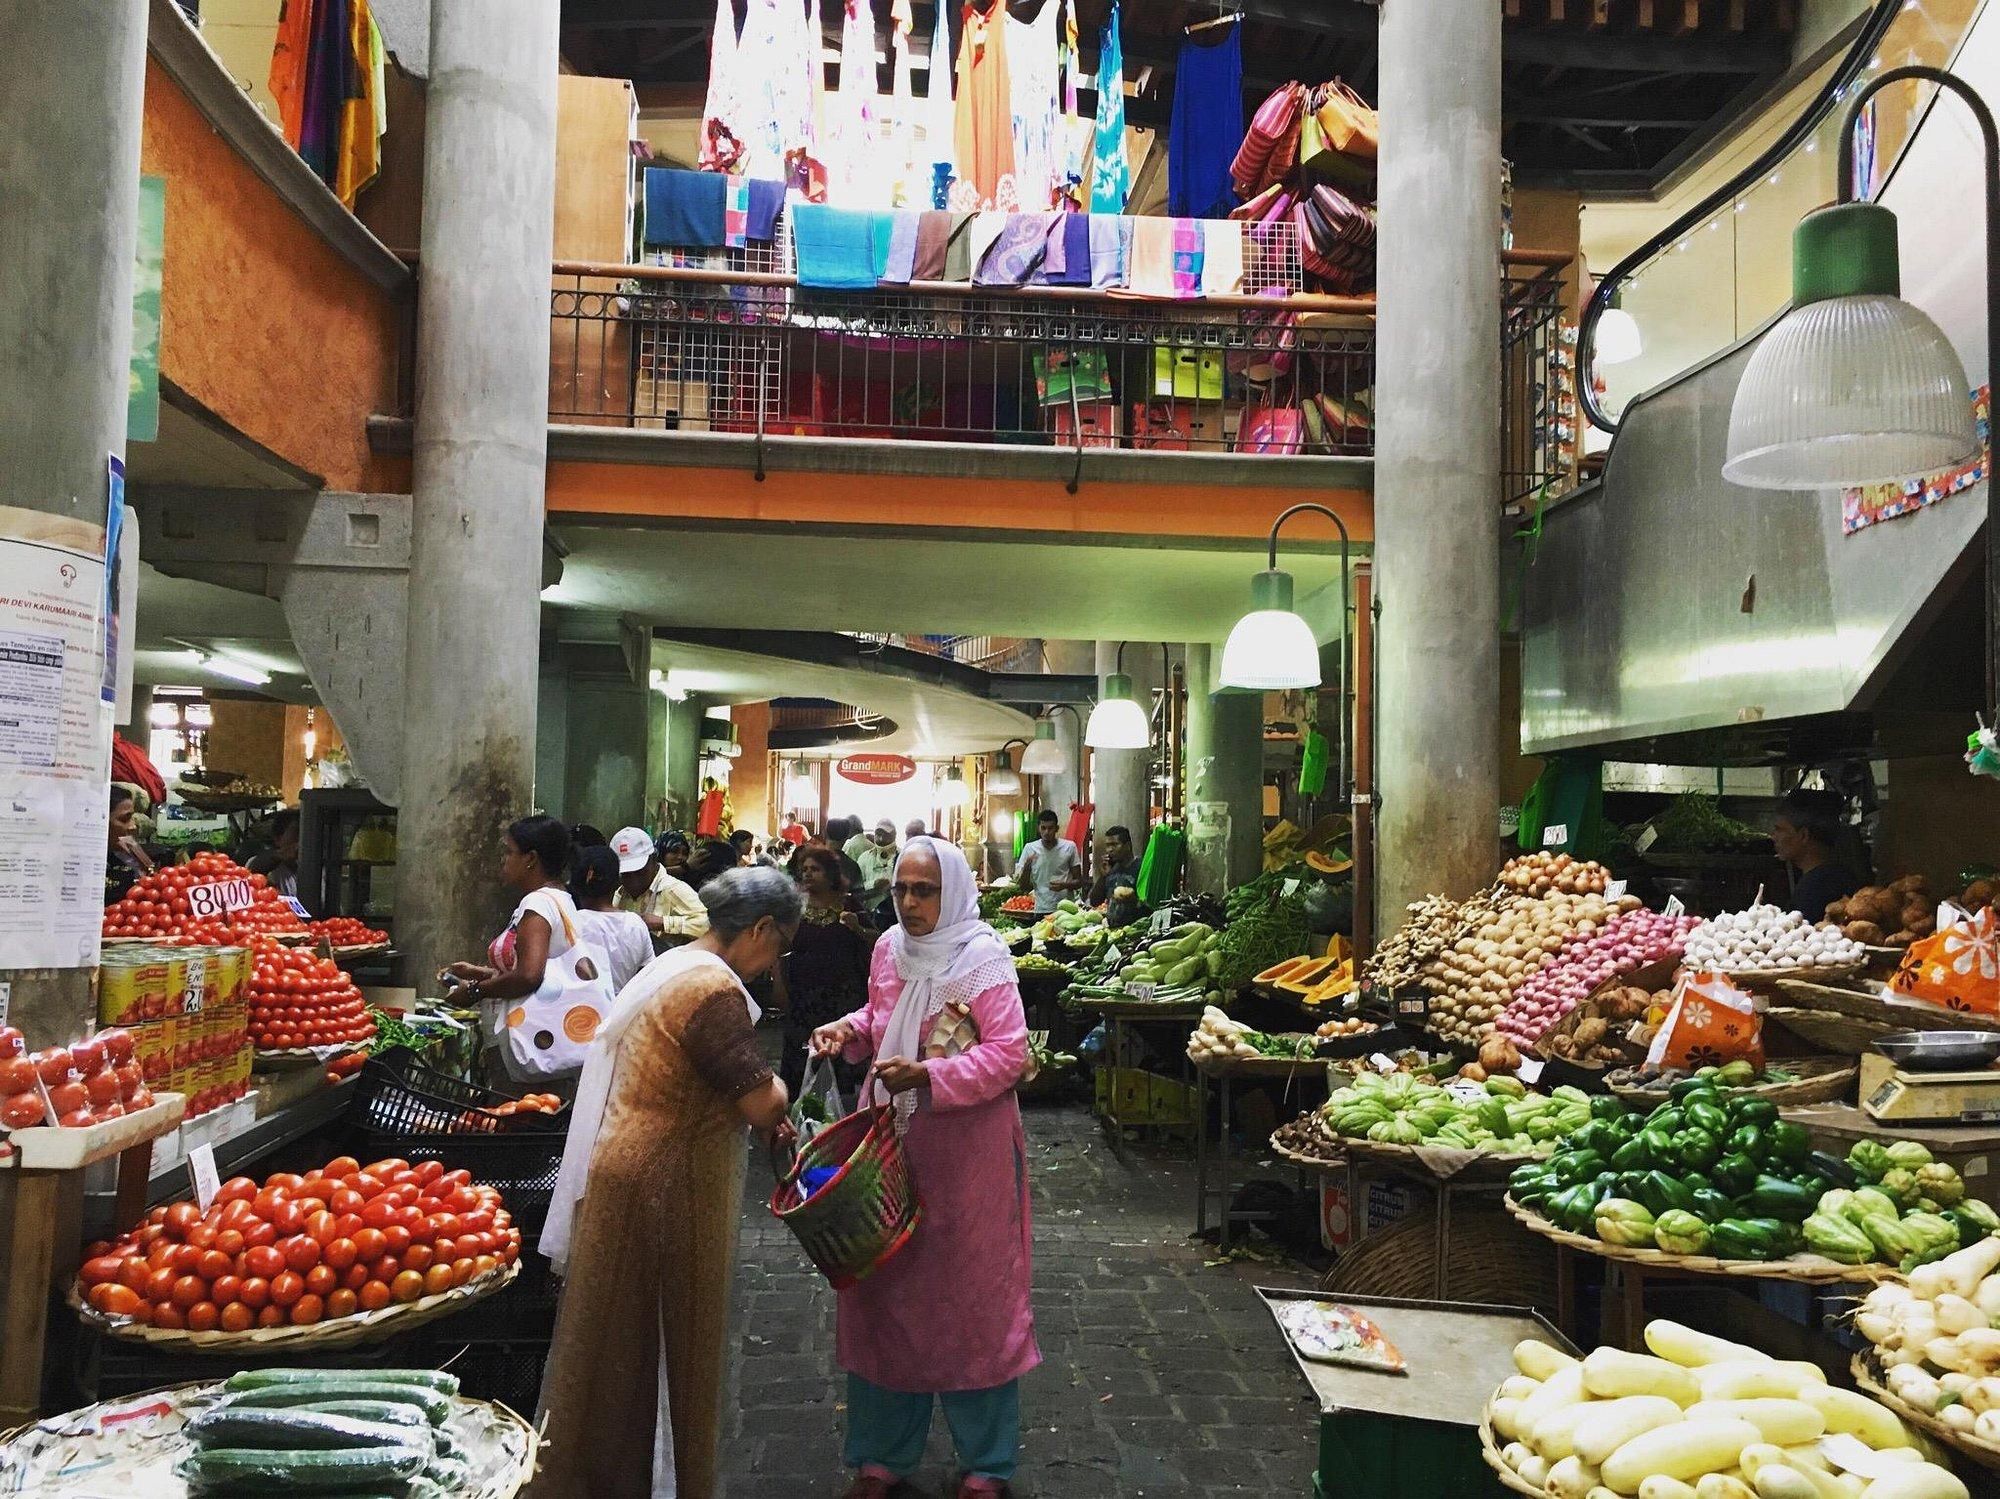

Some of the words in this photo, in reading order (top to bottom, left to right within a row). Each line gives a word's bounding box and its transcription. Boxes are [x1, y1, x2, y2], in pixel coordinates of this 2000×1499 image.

[11, 598, 32, 609] DEVI
[33, 602, 77, 617] KARUMAARI
[841, 759, 901, 772] GrandMARK
[1370, 1188, 1404, 1206] CITRUS
